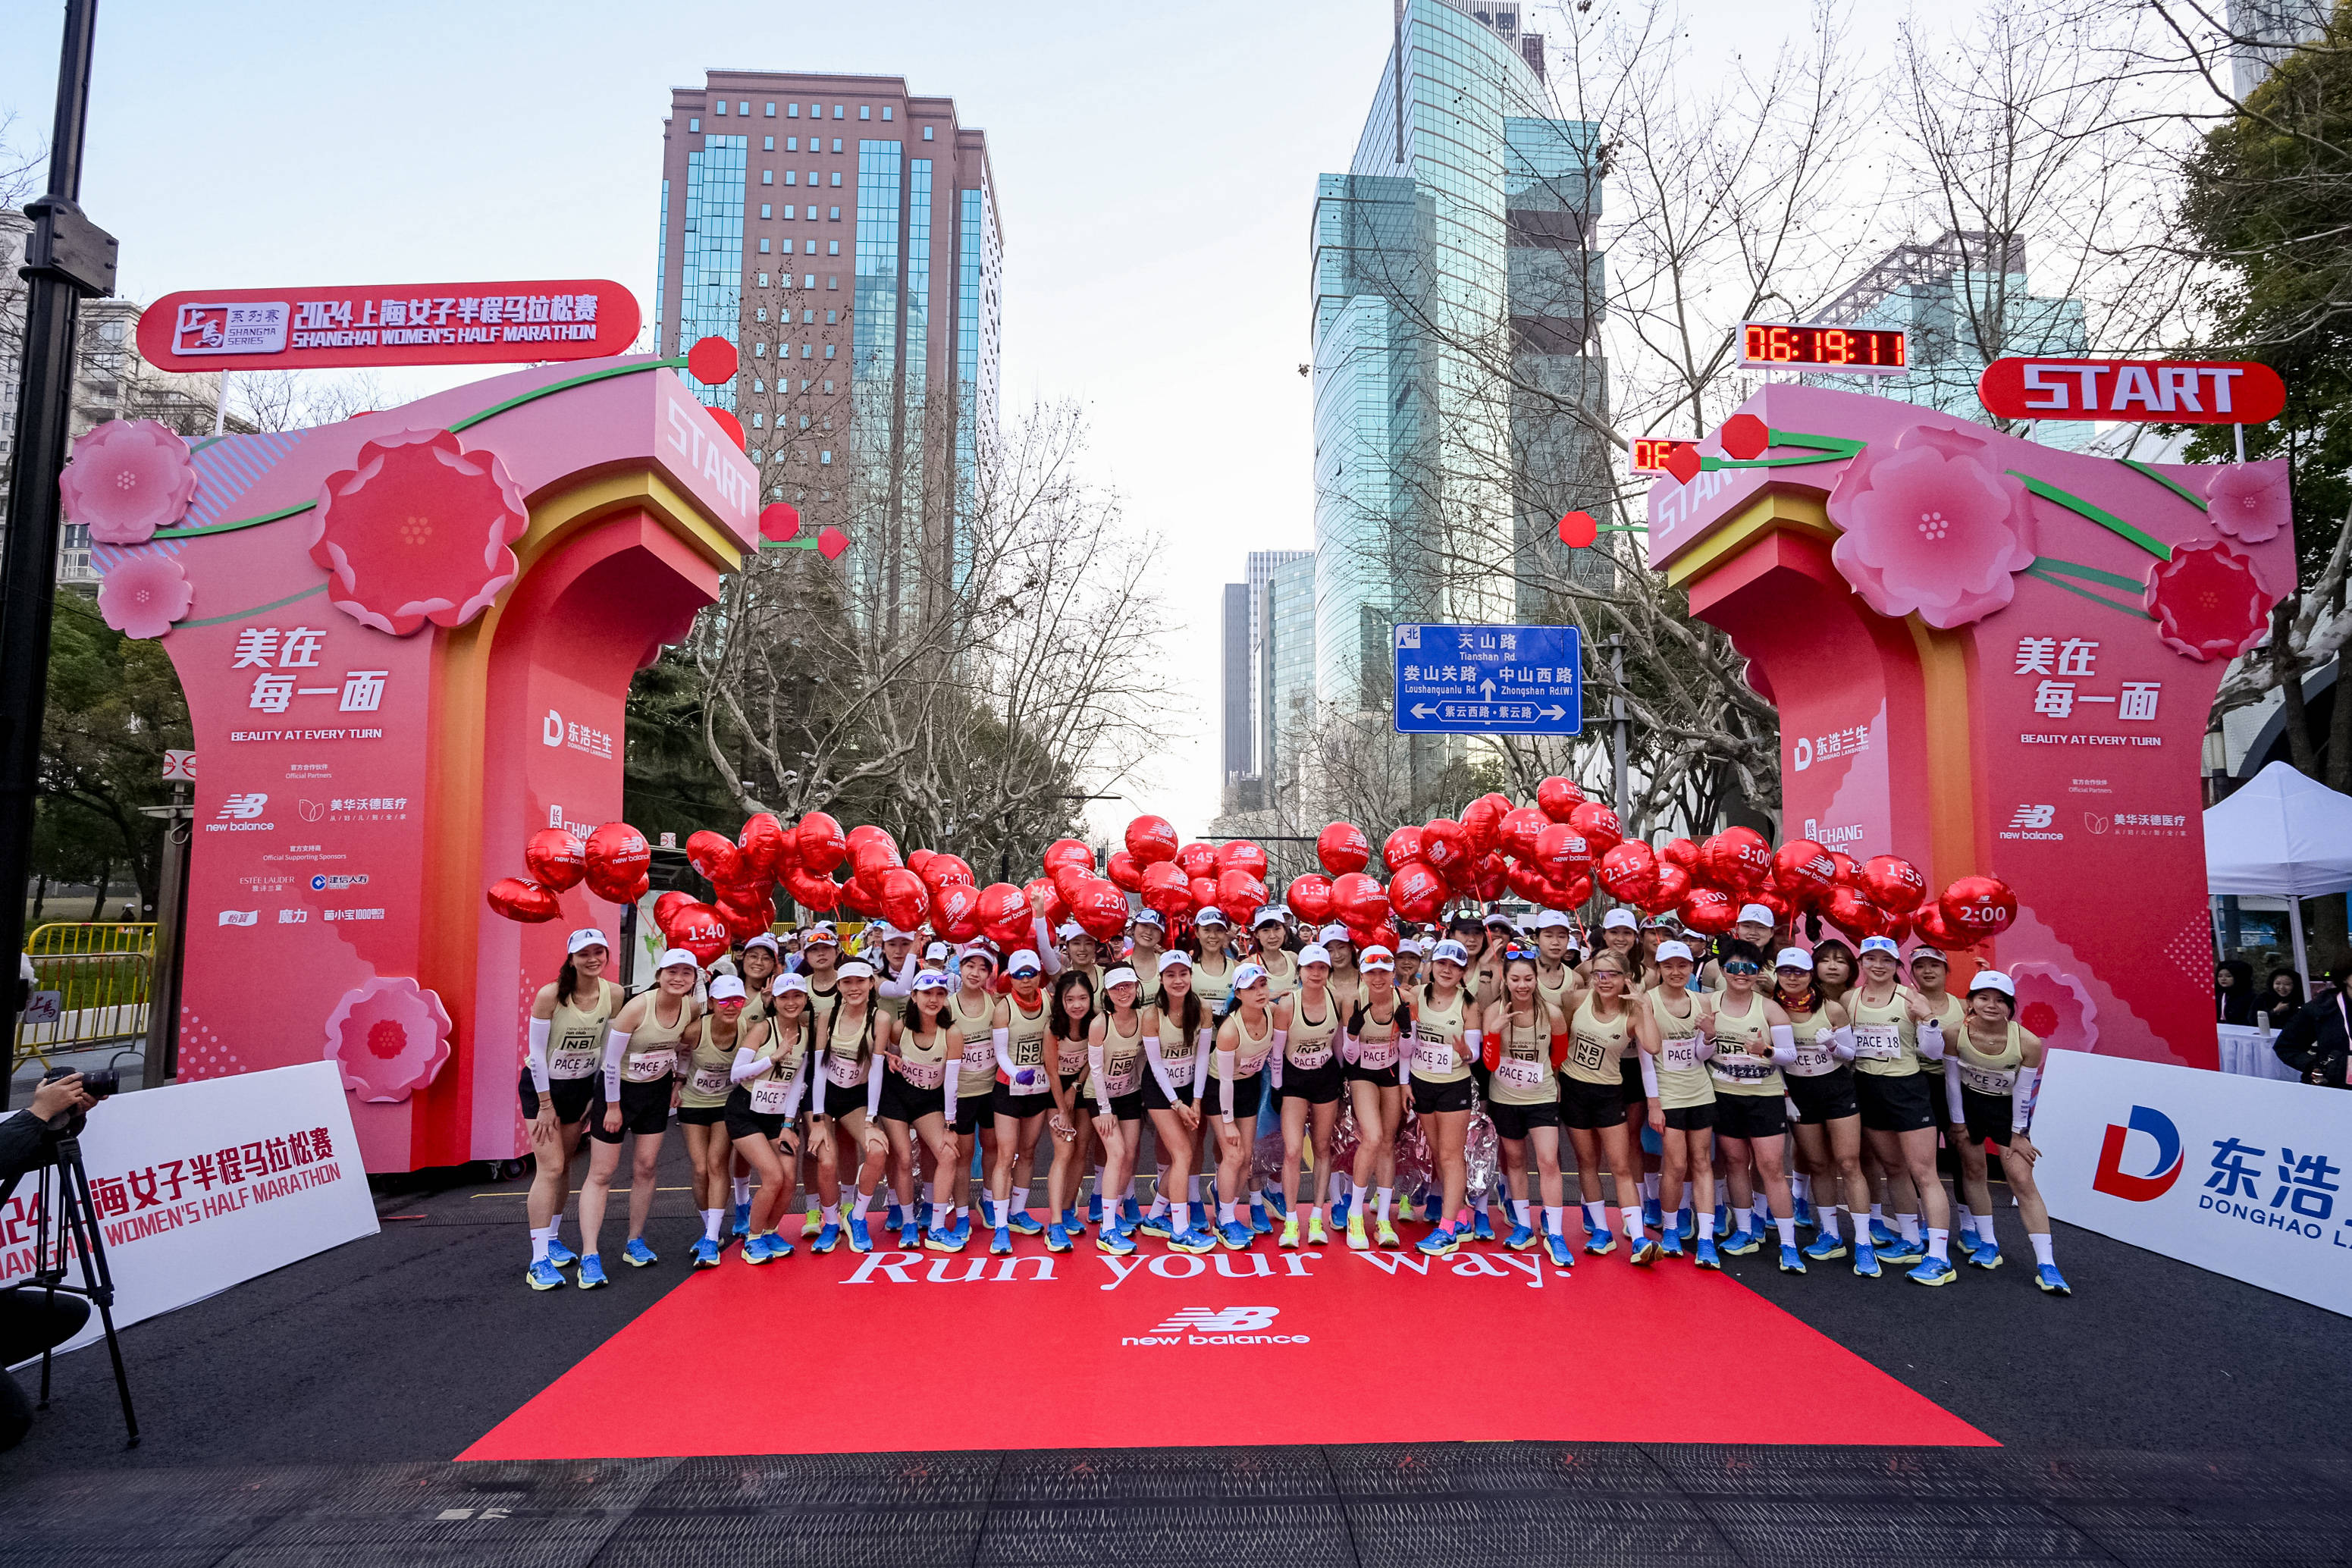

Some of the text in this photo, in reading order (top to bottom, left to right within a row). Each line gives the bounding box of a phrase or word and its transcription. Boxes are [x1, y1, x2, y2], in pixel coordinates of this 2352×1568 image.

[293, 294, 598, 329] 2024上海女子半程马拉松赛
[227, 337, 263, 346] SERIES
[292, 325, 597, 349] SHANGHAI WOMEN'S HALF MARATHON
[1745, 327, 1903, 365] 06:19:11
[2024, 364, 2244, 412] START
[668, 397, 751, 518] START
[1406, 629, 1419, 640] 北
[231, 626, 327, 669] 美在
[1458, 633, 1516, 650] 天山路
[1460, 652, 1517, 661] Tianshan Rd.
[2014, 637, 2099, 676] 美在
[1404, 665, 1477, 682] 娄山关路
[1499, 666, 1573, 683] 中山西路
[249, 670, 389, 713] 每一面
[1405, 685, 1477, 696] Loushanguanlu Rd.
[1501, 685, 1545, 697] Zhongshan
[2034, 680, 2161, 720] 每一面
[231, 729, 382, 742] BEAUTY AT EVERY TURN
[569, 722, 612, 754] 东浩兰生
[1817, 725, 1869, 755] 东浩兰生
[2021, 734, 2161, 745] BEAUTY AT EVERY TURN
[330, 798, 407, 811] 美华沃德医疗
[1592, 812, 1621, 834] 1:55
[2115, 814, 2185, 826] 美华沃德医疗
[206, 822, 274, 832] new balance
[1819, 824, 1863, 844] CHANG
[2000, 831, 2063, 840] new balance
[285, 854, 318, 862] Supporting
[1182, 852, 1213, 865] 1:45
[1388, 841, 1419, 864] 2:15
[1739, 845, 1770, 867] 3:00
[1604, 857, 1641, 882] 2:15
[1795, 867, 1811, 877] new
[1887, 864, 1923, 887] 1:55
[940, 873, 970, 887] 2:30
[1094, 893, 1126, 911] 2:30
[1403, 884, 1438, 910] new balance
[1692, 892, 1727, 908] 3:00
[999, 915, 1012, 925] new
[1960, 906, 2006, 922] 2:00
[688, 924, 725, 940] 1:40
[949, 920, 959, 932] new
[567, 1041, 589, 1049] NB
[1022, 1043, 1040, 1053] NB
[1857, 1036, 1899, 1049] PACE 18
[961, 1049, 995, 1063] PACE 32
[1171, 1049, 1189, 1057] NB
[1579, 1043, 1599, 1056] NB
[1668, 1049, 1692, 1061] PACE
[1021, 1054, 1039, 1063] RC
[1295, 1057, 1316, 1066] PACE
[1364, 1051, 1385, 1062] PACE
[1415, 1049, 1448, 1065] PACE 26
[1577, 1052, 1597, 1066] RC
[1815, 1053, 1827, 1065] 08
[554, 1058, 595, 1069] PACE 34
[635, 1062, 659, 1071] PACE
[1115, 1060, 1132, 1070] NB
[829, 1061, 859, 1080] PACE 29
[902, 1065, 924, 1077] PACE
[1500, 1066, 1538, 1083] PACE 28
[697, 1078, 721, 1088] PACE
[1037, 1074, 1046, 1084] 04
[1995, 1078, 2009, 1087] 22
[756, 1091, 777, 1103] PACE
[105, 1201, 200, 1247] WOMEN'S
[203, 1187, 249, 1219] HALF
[252, 1162, 341, 1204] MARATHON
[2200, 1194, 2352, 1250] DONGHAO L
[839, 1252, 1571, 1290] Run your way.
[1122, 1334, 1310, 1346] new balance
